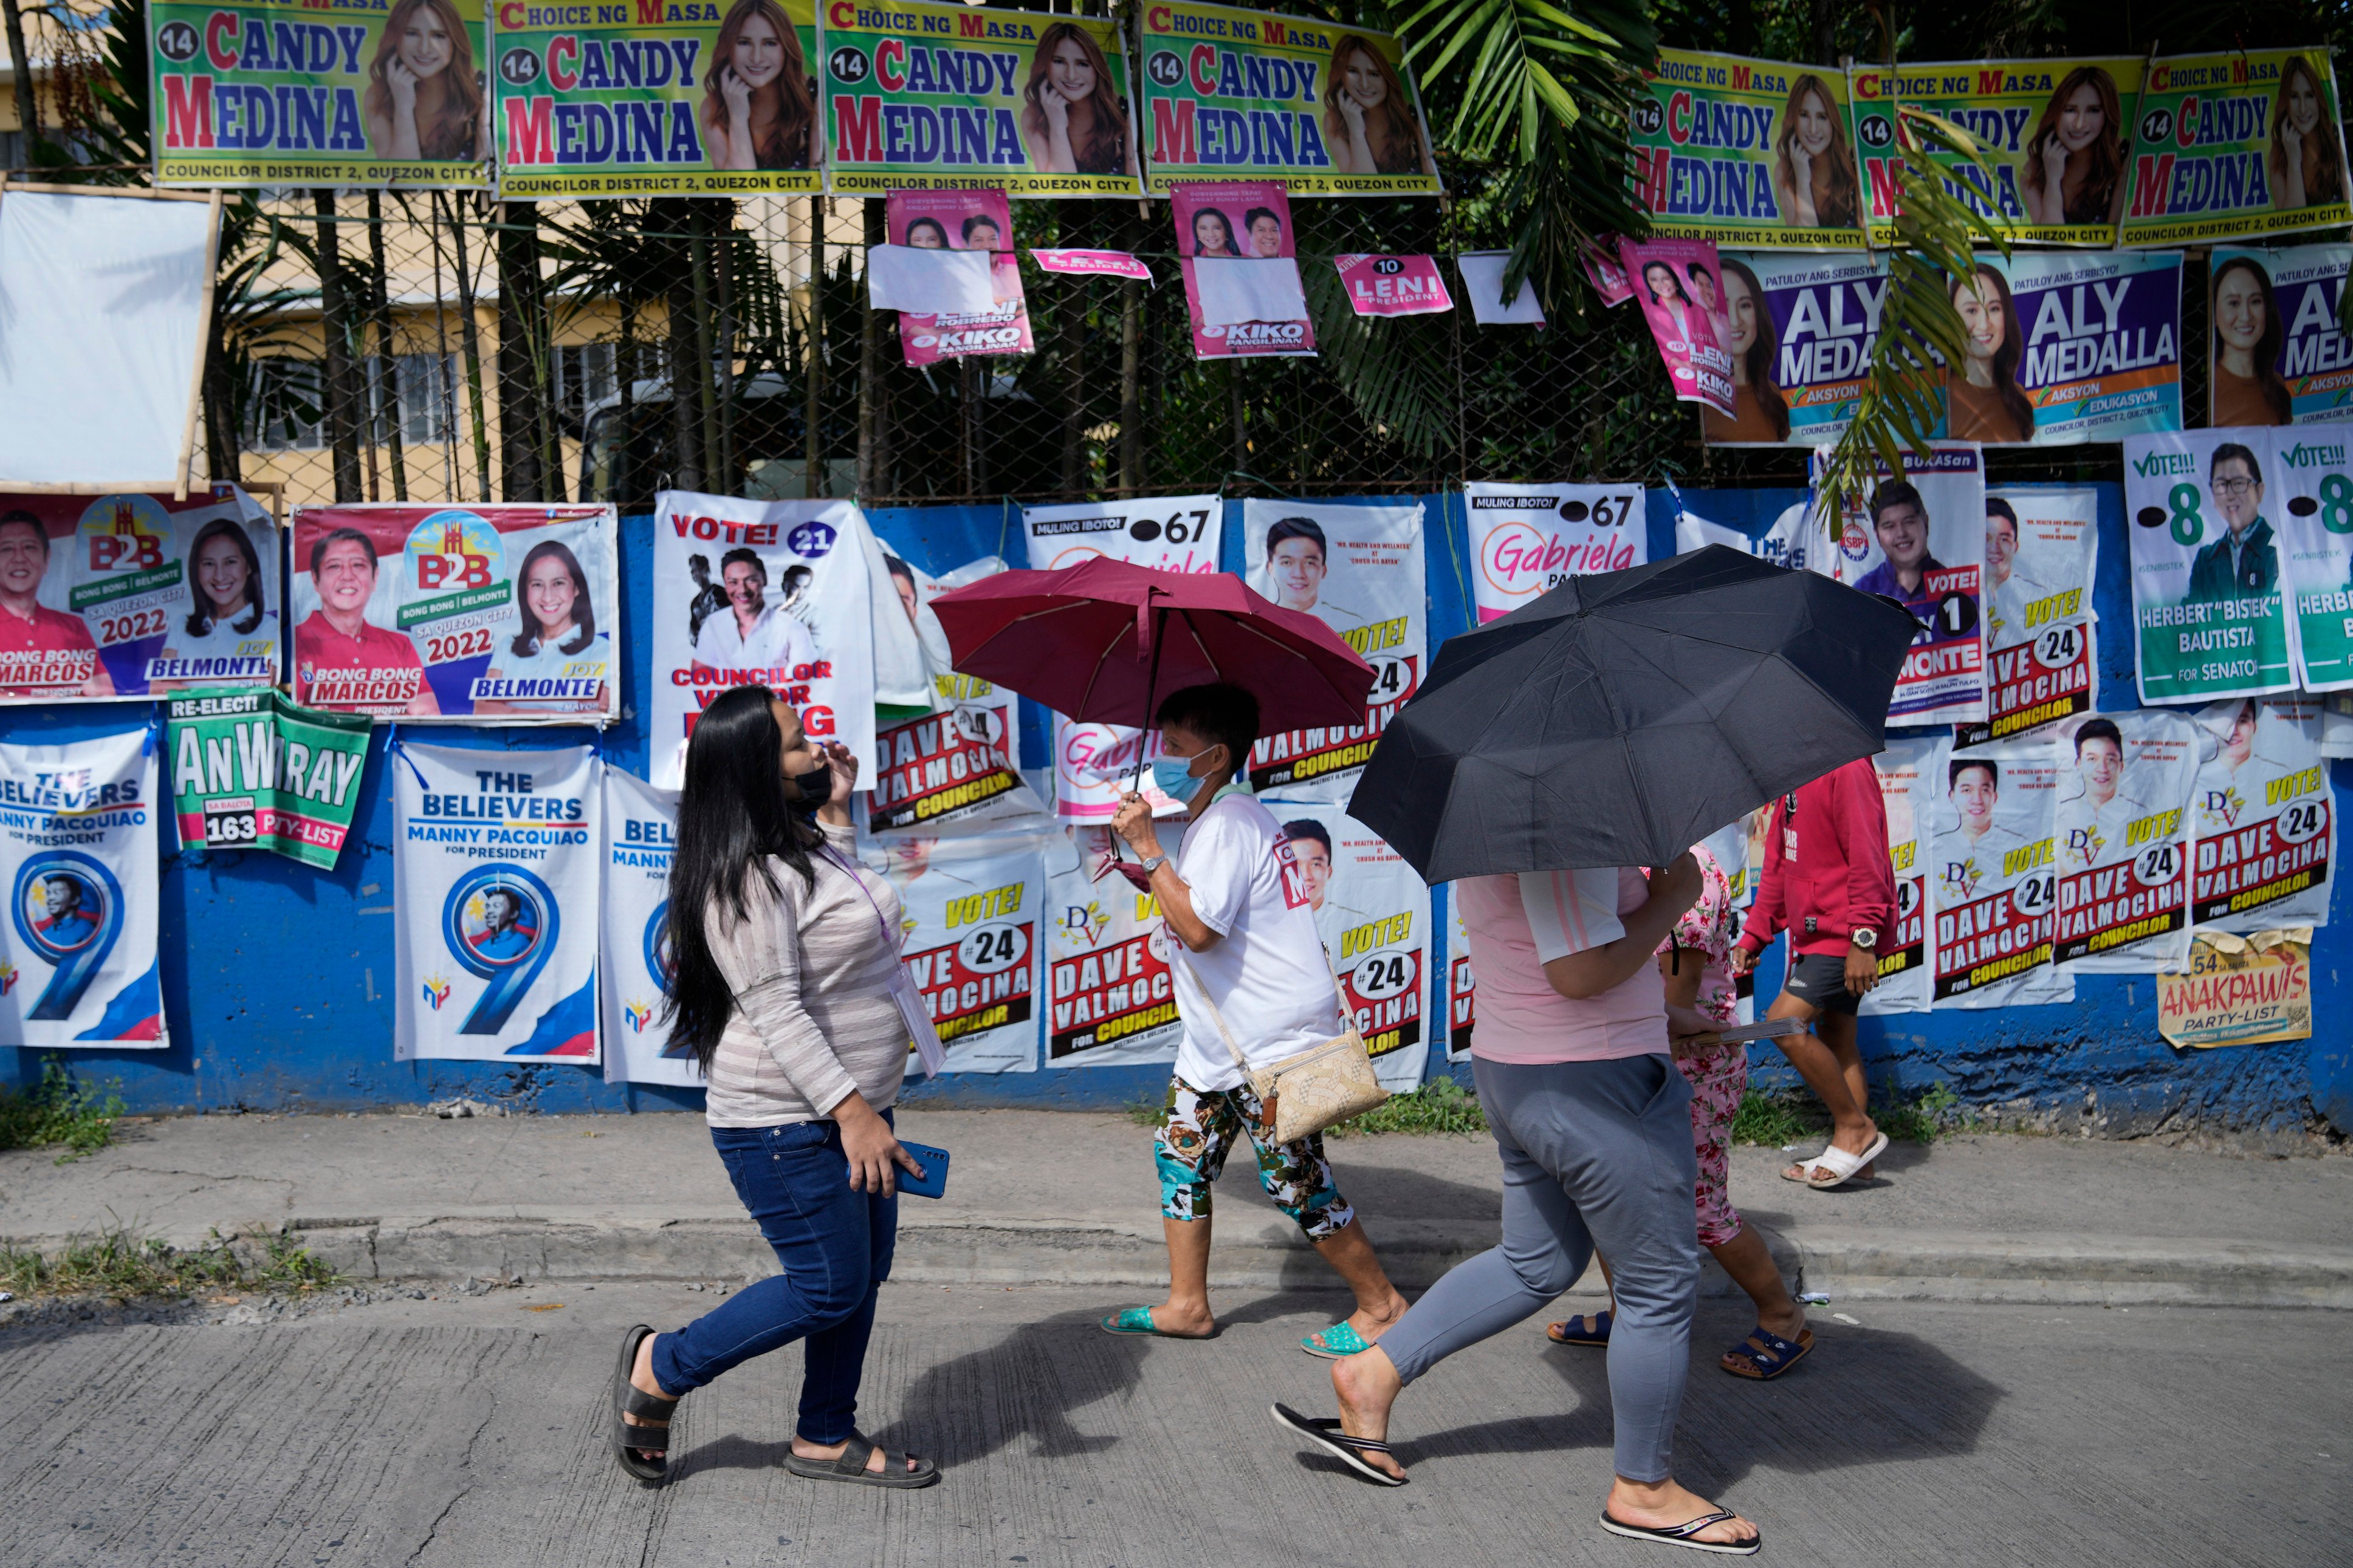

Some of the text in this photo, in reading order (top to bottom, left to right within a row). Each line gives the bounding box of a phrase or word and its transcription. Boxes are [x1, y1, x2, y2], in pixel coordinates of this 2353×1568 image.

[830, 1, 1036, 40] CHOICE NG MASA
[1149, 7, 1331, 50] CHOICE NG MASA
[206, 11, 366, 74] CANDY
[548, 35, 701, 92] CANDY
[834, 53, 863, 77] 14
[875, 39, 1019, 97] CANDY
[1153, 58, 1179, 80] 14
[1189, 43, 1317, 102] CANDY
[2151, 60, 2279, 91] CHOICE NG MASA
[1706, 65, 1788, 93] NG MASA
[1857, 70, 2053, 97] CHOICE NG MASA
[162, 75, 366, 150] MEDINA
[1668, 91, 1774, 151] CANDY
[2146, 115, 2169, 137] 14
[2176, 95, 2268, 148] CANDY
[504, 95, 702, 165] MEDINA
[834, 95, 1025, 164] MEDINA
[1152, 98, 1329, 166] MEDINA
[1866, 122, 1888, 142] 14
[506, 177, 812, 193] COUNCILOR DISTRICT 2, QUEZON CITY
[837, 177, 1130, 192] COUNCILOR DISTRICT 2, QUEZON CITY
[1334, 179, 1428, 190] QUEZON CITY
[2129, 152, 2269, 218] MEDINA
[1705, 231, 1861, 244] DISTRICT QUEZON CITY
[2025, 230, 2109, 240] QUEZON CITY
[2126, 208, 2346, 242] COUNCILOR DISTRICT 2, QUEZON CITY
[1379, 260, 1397, 273] 10
[1765, 264, 1881, 287] PATULOY ANG SERBISYO!
[2015, 265, 2118, 290] PATULOY ANG SERBISYO!
[1355, 276, 1438, 297] LENI
[1369, 293, 1439, 306] PRESIDENT
[2028, 277, 2132, 346] ALY
[939, 327, 1022, 347] KIKO
[1226, 338, 1302, 346] PANGILINAN
[1228, 323, 1304, 340] KIKO
[2025, 323, 2176, 388] MEDALLA
[1807, 385, 1859, 403] AKSYON
[2051, 383, 2100, 402] AKSYON
[2090, 390, 2157, 413] EDUKASYON
[2133, 451, 2195, 478] VOTE!!!
[1477, 496, 1633, 526] MULING IBOTO! 67
[2169, 483, 2204, 544] 8
[672, 515, 830, 550] VOTE! 21
[1037, 510, 1210, 544] MULING IBOTO! 67
[91, 533, 163, 570] B2B
[1494, 533, 1635, 581] Gabriela
[1847, 537, 1863, 548] SBP
[419, 553, 491, 589] B2B
[1927, 570, 1977, 594] VOTE!
[403, 589, 507, 619] BONG BONG BELMONTE
[1943, 597, 1959, 631] 1
[2025, 587, 2082, 629] VOTE!
[2141, 601, 2212, 628] HERBERT
[100, 609, 168, 644] 2022
[2179, 627, 2255, 653] BAUTISTA
[427, 628, 494, 663] 2022
[316, 668, 422, 682] BONG BONG
[566, 663, 600, 677] JOY
[672, 661, 833, 685] COUNCILOR
[2178, 668, 2197, 681] FOR
[315, 682, 417, 700] MARCOS
[474, 679, 596, 697] BELMONTE
[172, 696, 258, 716] RE-ELECT!
[1992, 698, 2073, 738] COUNCILOR
[476, 771, 532, 792] THE
[2266, 765, 2321, 806] VOTE!
[222, 800, 253, 809] BALOTA
[424, 795, 582, 820] BELIEVERS
[43, 812, 145, 830] PACQUIAO
[207, 815, 256, 841] 163
[409, 827, 588, 845] MANNY PACQUIAO
[2127, 807, 2182, 847] VOTE!
[469, 847, 546, 860] PRESIDENT
[2198, 823, 2272, 873] DAVE
[2197, 837, 2326, 899] VALMOCINA
[2061, 864, 2128, 912] DAVE
[2210, 904, 2228, 916] FOR
[2231, 872, 2310, 911] COUNCILOR
[946, 882, 1025, 929] VOTE!
[2061, 880, 2183, 940] VALMOCINA
[1341, 911, 1413, 959] VOTE!
[1939, 895, 2008, 947] DAVE
[2067, 945, 2086, 957] FOR
[2089, 914, 2170, 951] COUNCILOR
[965, 930, 1014, 964] #24
[1056, 940, 1143, 1000] DAVE
[1357, 957, 1404, 992] #24
[1951, 978, 1969, 992] FOR
[1971, 944, 2053, 985] COUNCILOR
[2161, 964, 2306, 1018] ANAKPAWIS
[2184, 1005, 2279, 1031] PARTY-LIST
